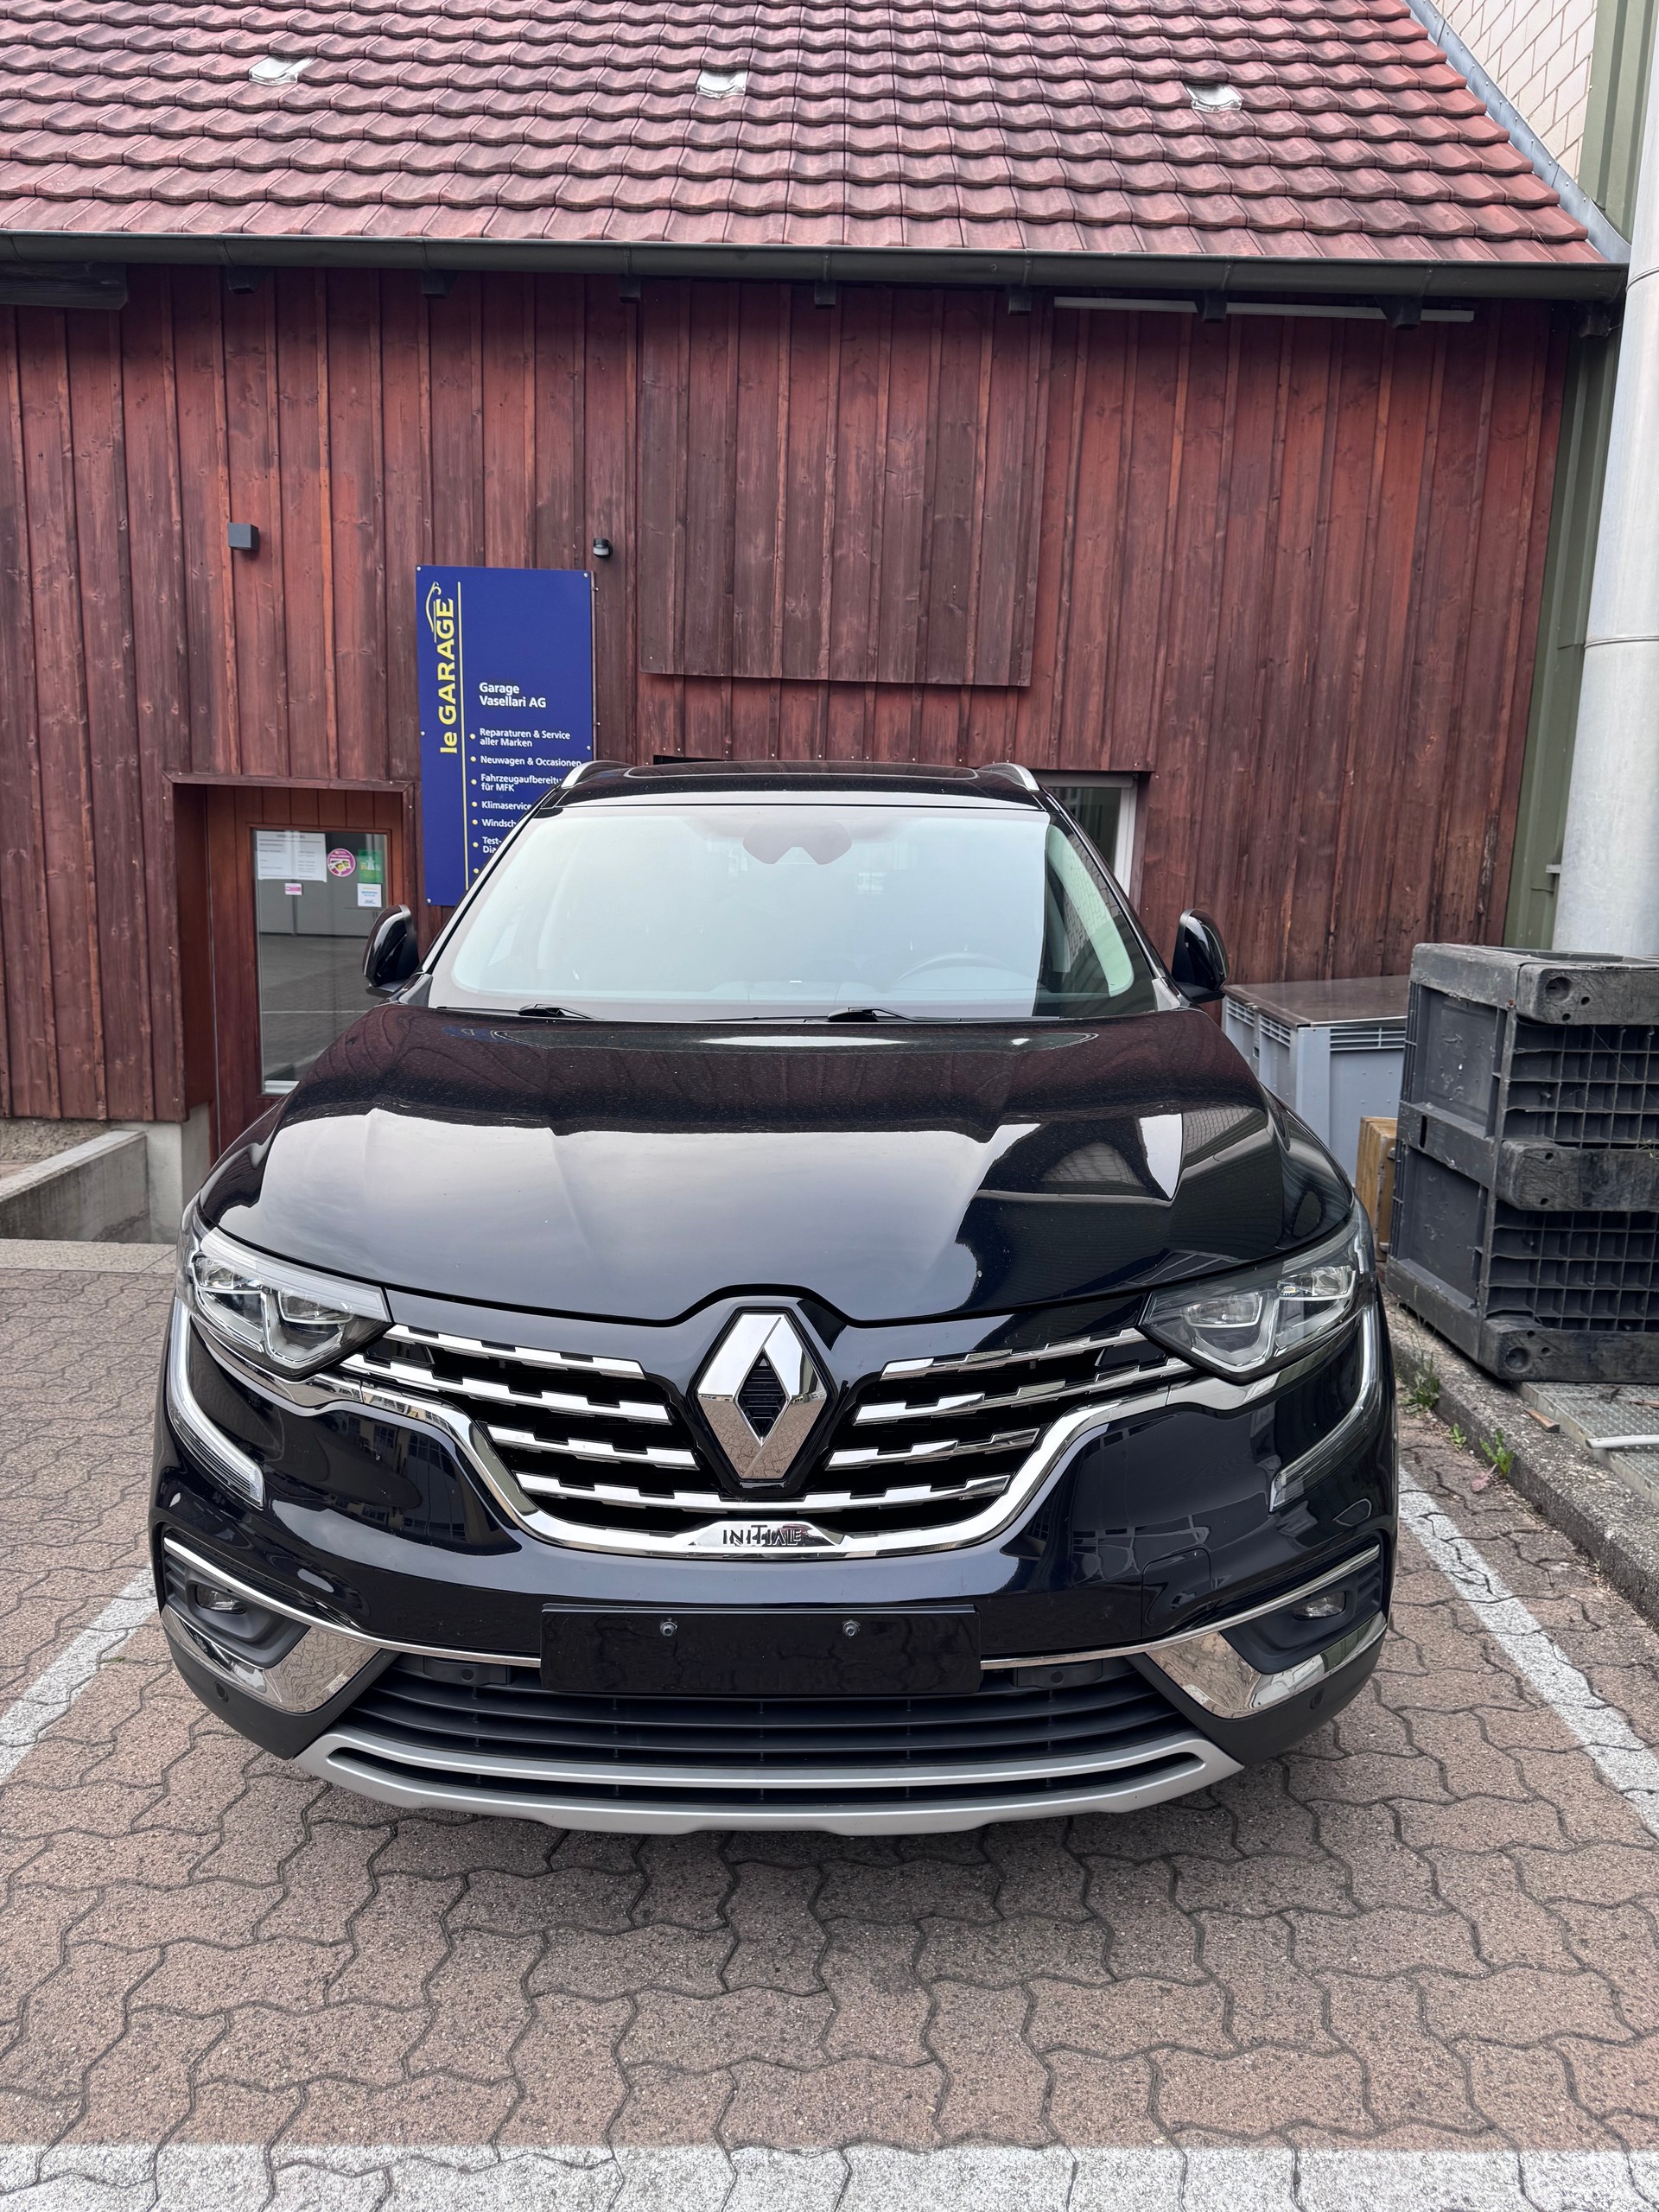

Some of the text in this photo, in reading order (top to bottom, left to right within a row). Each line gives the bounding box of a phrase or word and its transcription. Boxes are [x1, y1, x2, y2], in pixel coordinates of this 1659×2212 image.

[436, 598, 458, 753] le GARAGE
[479, 682, 520, 696] Garage
[479, 695, 547, 709] Vasellari AG
[480, 728, 571, 741] Reparaturen & Service
[480, 737, 533, 747] aller Marken
[480, 755, 582, 767] Neuwagen & Occasionen
[495, 783, 515, 792] MFK
[481, 800, 532, 810] Klimaservice
[722, 1524, 802, 1546] INITIALE
